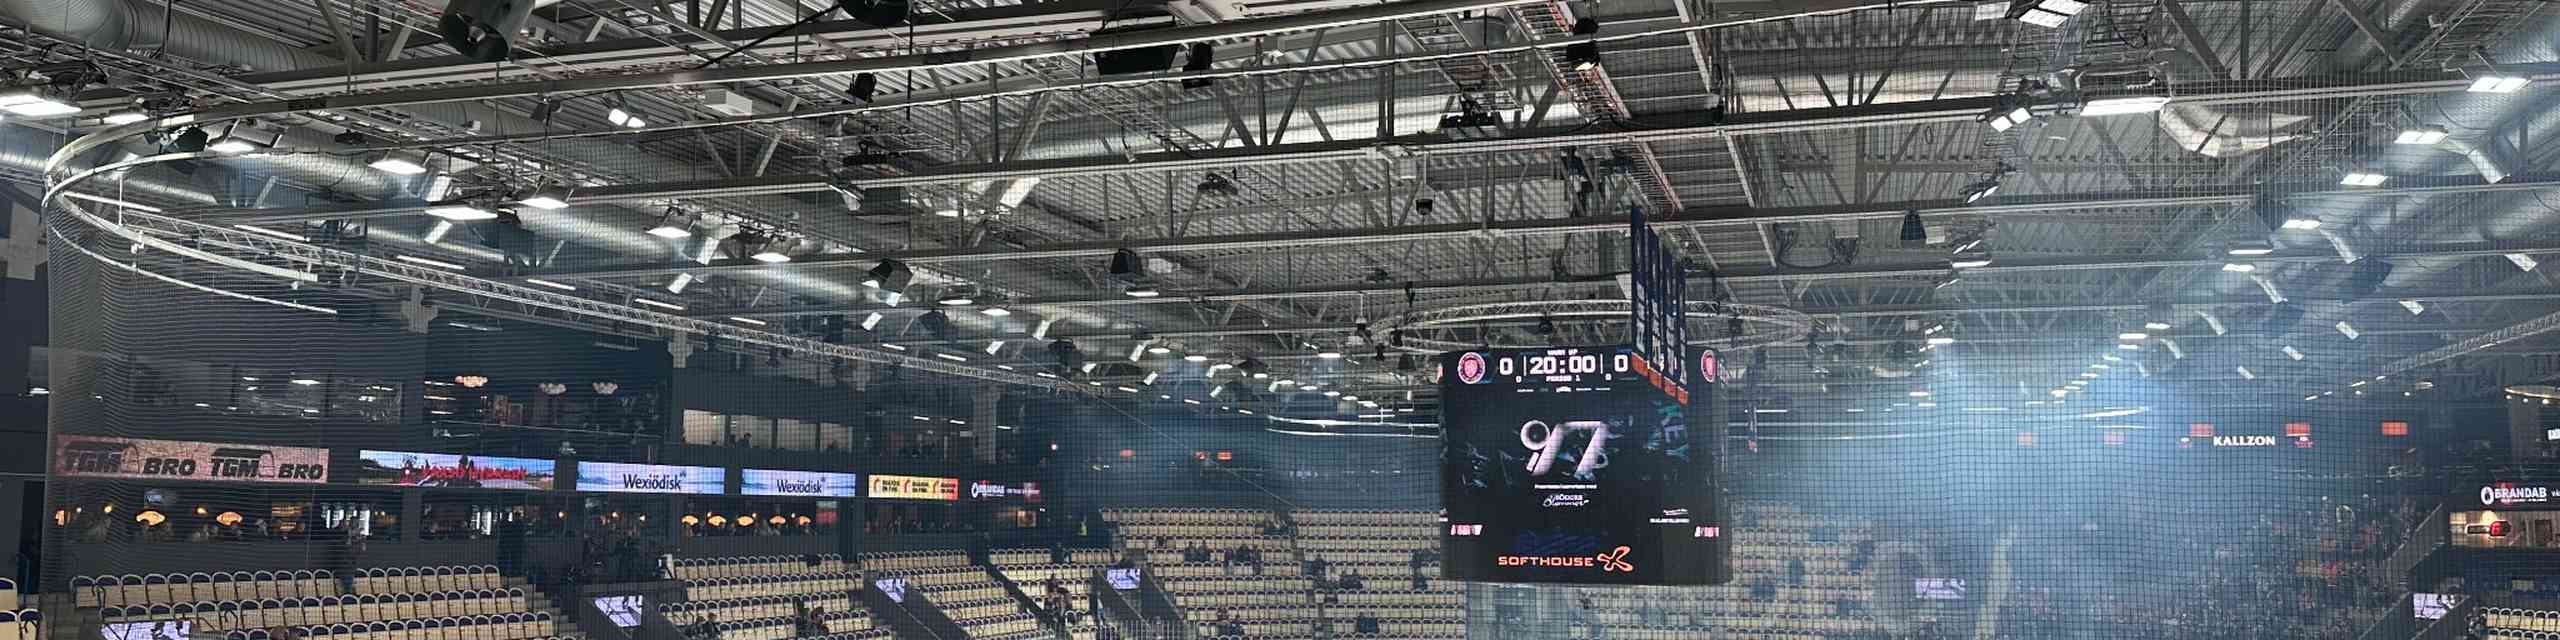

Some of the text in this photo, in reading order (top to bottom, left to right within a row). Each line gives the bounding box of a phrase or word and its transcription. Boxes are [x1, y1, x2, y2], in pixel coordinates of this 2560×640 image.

[1500, 357, 1514, 375] 0
[1529, 355, 1596, 375] 20:00
[1614, 354, 1629, 373] 0
[2213, 434, 2276, 446] KALLZON
[143, 458, 197, 477] BRO
[208, 457, 324, 481] TGM BRO
[623, 472, 682, 491] Wexiödisk
[776, 479, 822, 494] Wexiödisk
[2494, 487, 2547, 499] BRANDAB
[1498, 555, 1595, 567] SOFTHOUSE
